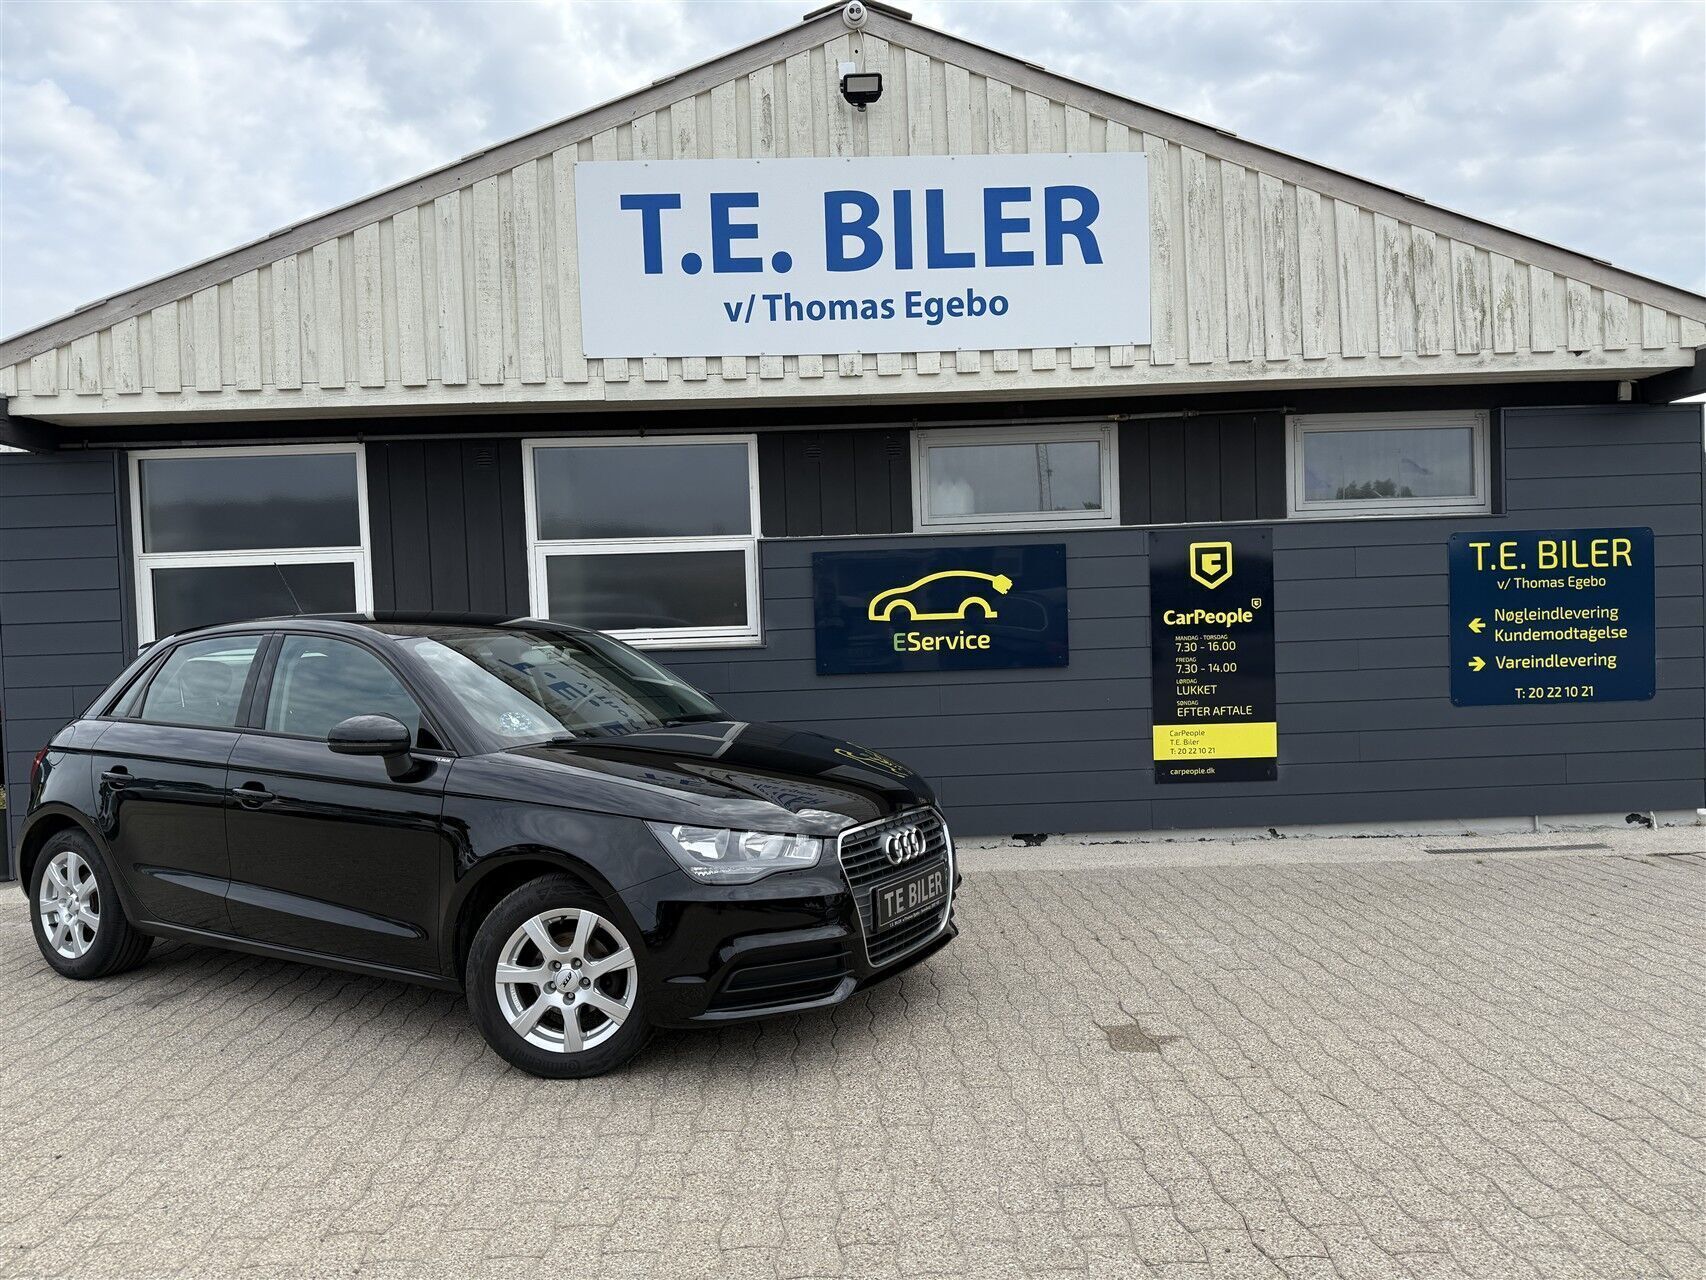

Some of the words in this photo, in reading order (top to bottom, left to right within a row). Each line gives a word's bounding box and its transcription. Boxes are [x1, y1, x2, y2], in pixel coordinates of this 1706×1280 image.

[620, 192, 793, 276] T.E.
[823, 184, 1104, 273] BILER
[723, 294, 755, 324] v/
[763, 292, 896, 322] Thomas
[904, 287, 1009, 326] Egebo
[1468, 541, 1526, 571] T.E.
[1538, 538, 1633, 570] BILER
[1496, 577, 1512, 590] v/
[1513, 576, 1565, 589] Thomas
[1567, 575, 1607, 590] Egebo
[1163, 608, 1253, 628] CarPeople
[1494, 605, 1619, 624] Nøgleindlevering
[893, 630, 991, 652] EService
[1494, 625, 1628, 643] Kundemodtagelse
[1175, 642, 1198, 653] 7.30
[1207, 640, 1237, 652] 16.00
[1175, 663, 1198, 674] 7.30
[1207, 662, 1238, 673] 14.00
[1496, 652, 1617, 670] Vareindlevering
[1176, 684, 1218, 696] LUKKET
[1514, 687, 1526, 699] T:
[1528, 686, 1545, 699] 20
[1546, 686, 1562, 698] 22
[1564, 685, 1579, 698] 10
[1581, 685, 1594, 697] 21
[1177, 706, 1211, 717] EFTER
[1212, 705, 1253, 716] AFTALE
[1169, 729, 1206, 738] CarPeople
[1183, 738, 1200, 746] Biler
[1188, 747, 1197, 755] 22
[1207, 746, 1216, 754] 21
[1169, 767, 1216, 776] carpeople.dk
[908, 871, 943, 908] BILER
